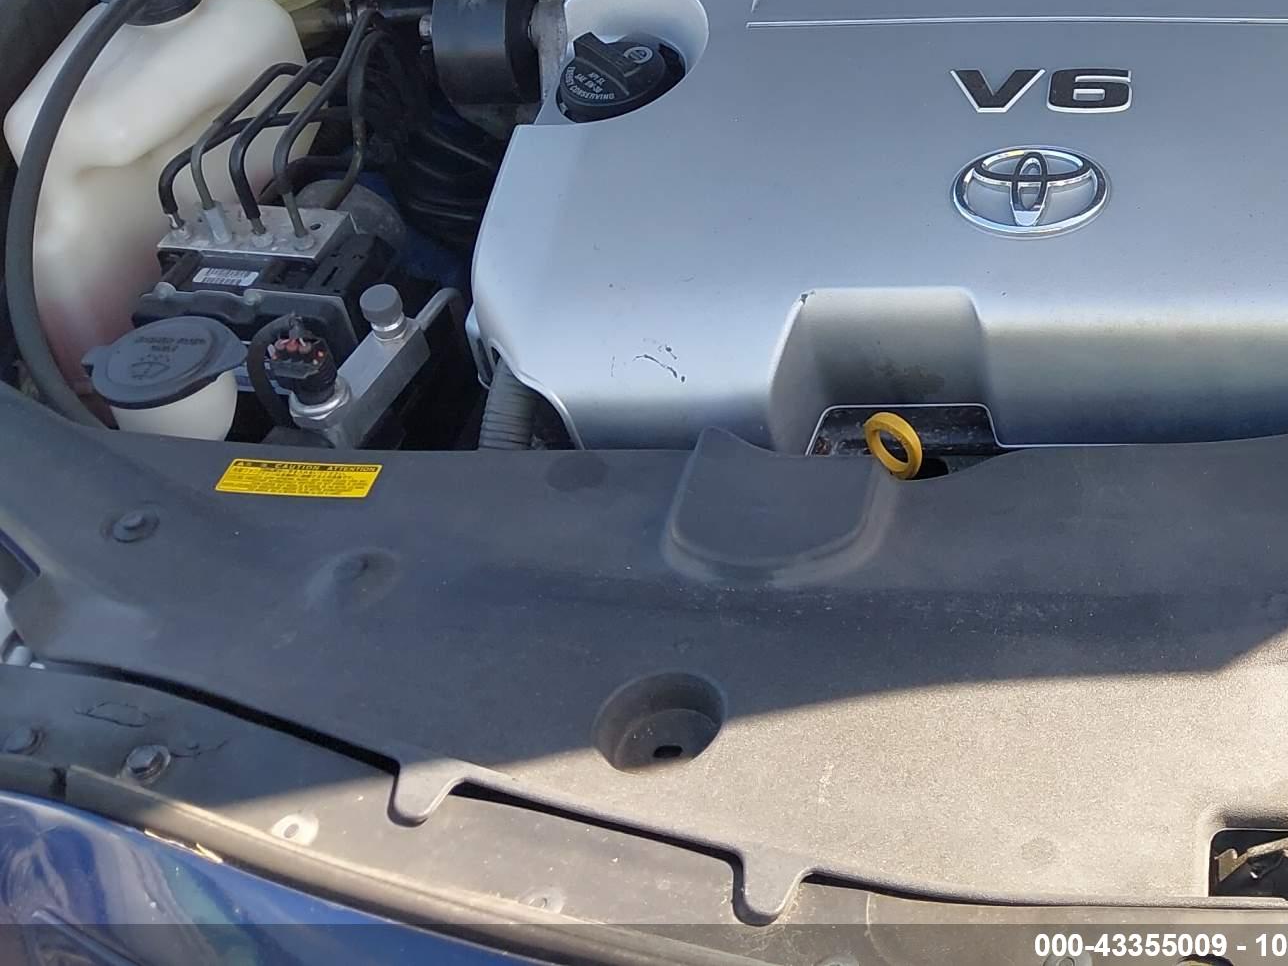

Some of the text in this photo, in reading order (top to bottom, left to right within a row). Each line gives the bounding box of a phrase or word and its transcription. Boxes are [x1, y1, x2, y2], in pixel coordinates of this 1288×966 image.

[569, 85, 615, 100] CONSERVING
[950, 68, 1132, 114] V6
[275, 463, 320, 471] CAUTION
